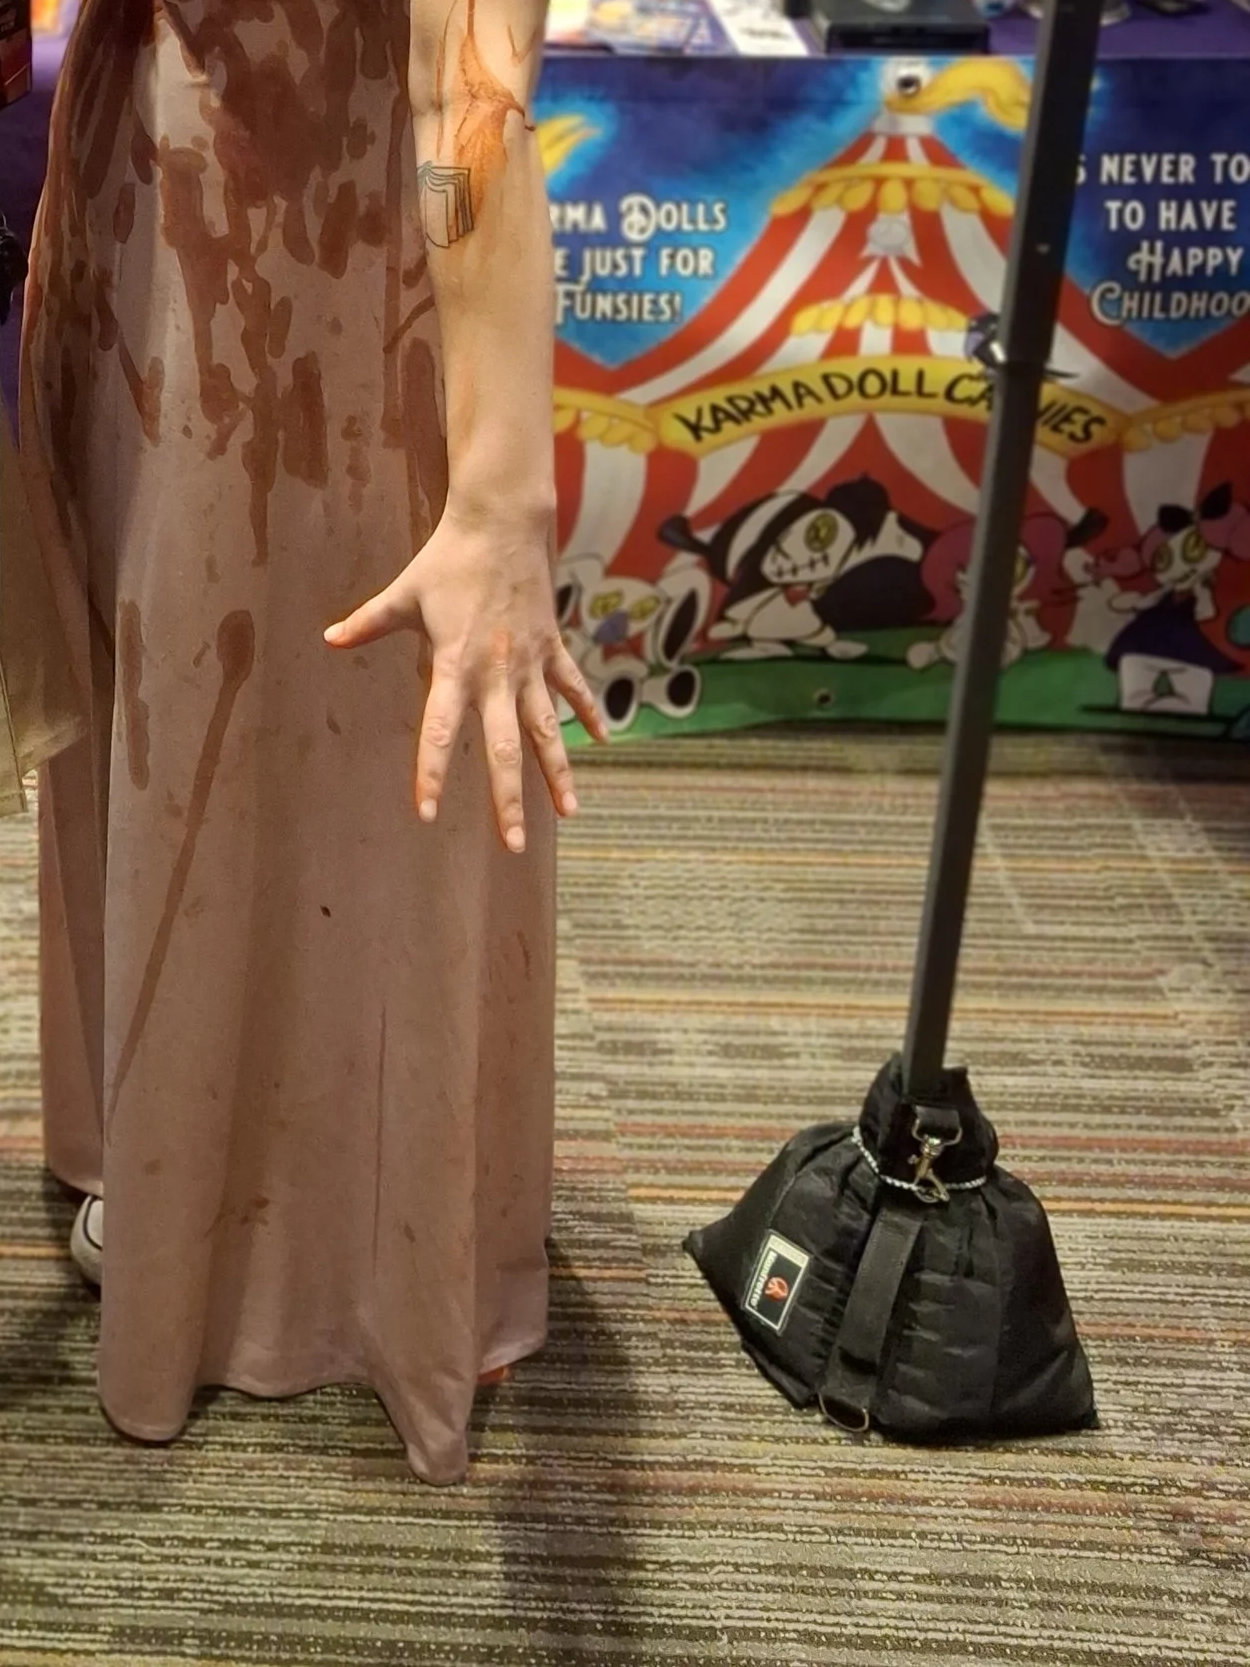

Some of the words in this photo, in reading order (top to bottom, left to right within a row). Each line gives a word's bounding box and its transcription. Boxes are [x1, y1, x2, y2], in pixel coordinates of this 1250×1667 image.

[1100, 153, 1196, 184] NEVER
[619, 192, 728, 243] DOLLS
[1104, 200, 1145, 231] TO
[1159, 200, 1237, 231] HAVE
[579, 247, 645, 284] JUST
[659, 247, 715, 277] FOR
[1126, 240, 1244, 283] HAPPY
[674, 381, 823, 442] KARMA
[821, 368, 937, 401] DOLL
